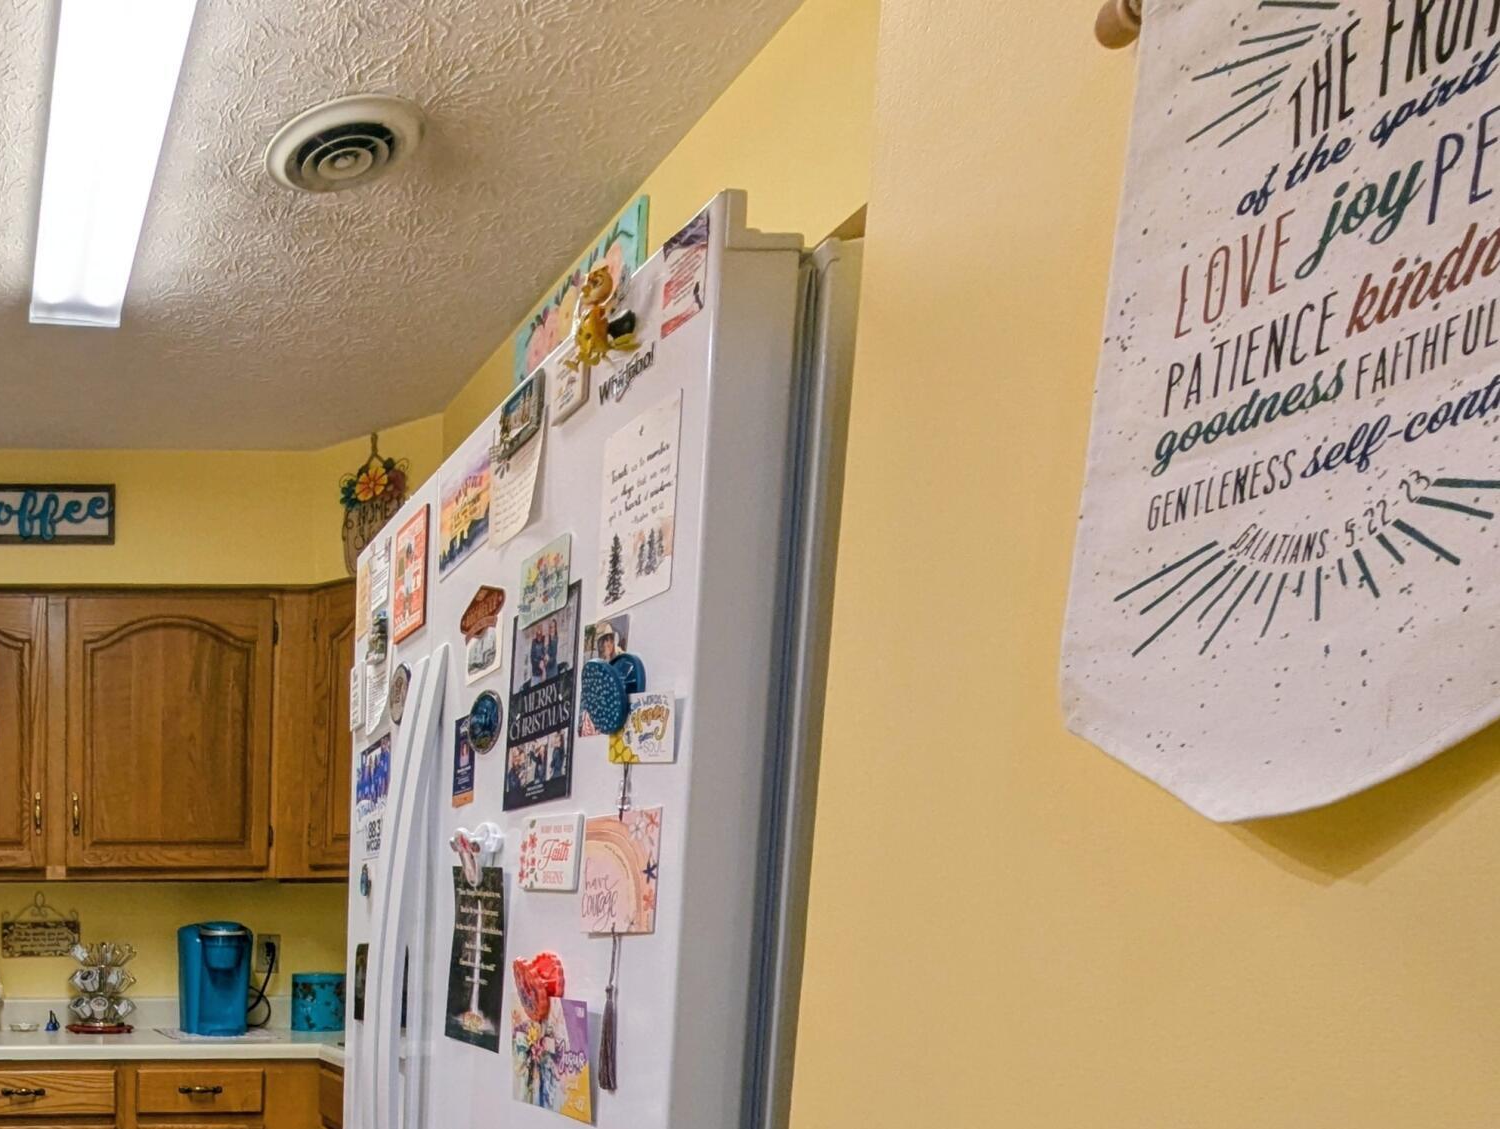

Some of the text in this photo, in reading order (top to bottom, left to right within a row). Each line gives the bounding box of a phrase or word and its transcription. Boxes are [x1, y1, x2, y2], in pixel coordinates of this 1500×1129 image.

[1237, 38, 1500, 217] of the spirit
[1287, 18, 1361, 148] THE
[1174, 209, 1295, 339] LOVE
[1295, 160, 1426, 279] joy
[1151, 297, 1498, 476] goodness FAITHFUL
[1163, 291, 1338, 417] PATIENCE
[1147, 449, 1298, 531] GENTLENESS
[1230, 522, 1332, 565] GALATIANS
[509, 700, 570, 740] CHRISTMAS
[523, 683, 558, 713] MERRY
[585, 857, 619, 891] have
